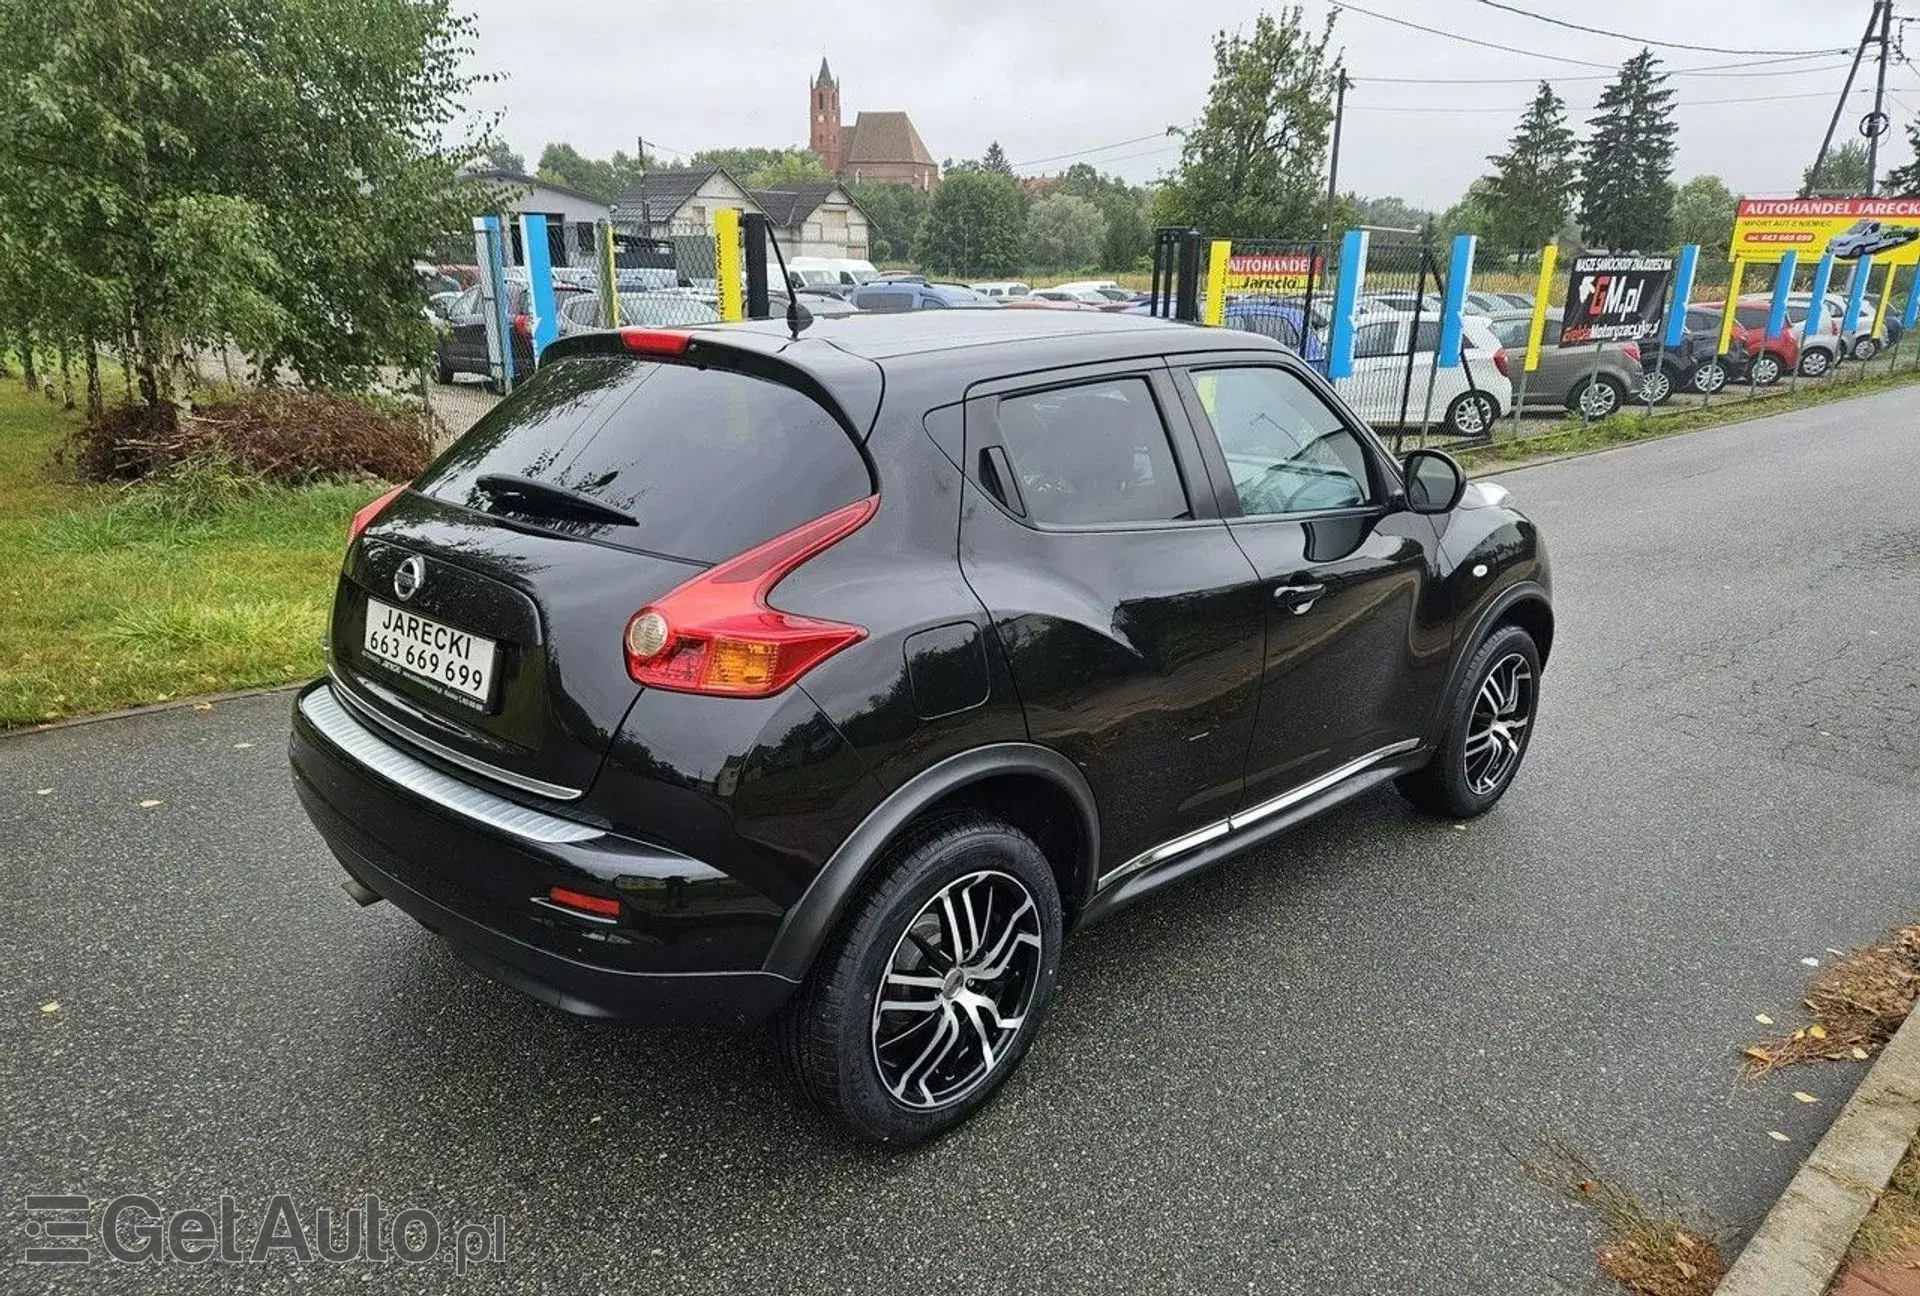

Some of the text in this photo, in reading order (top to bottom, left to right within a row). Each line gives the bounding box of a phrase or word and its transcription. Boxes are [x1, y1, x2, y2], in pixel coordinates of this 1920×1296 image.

[1745, 202, 1920, 214] AUTOHANDEL JARECK
[1228, 258, 1309, 272] AUTOHANDE
[1241, 276, 1298, 289] Jarecki
[382, 609, 471, 659] JARECKI
[370, 631, 400, 659] 663
[405, 645, 440, 674] 669
[445, 660, 483, 691] 699
